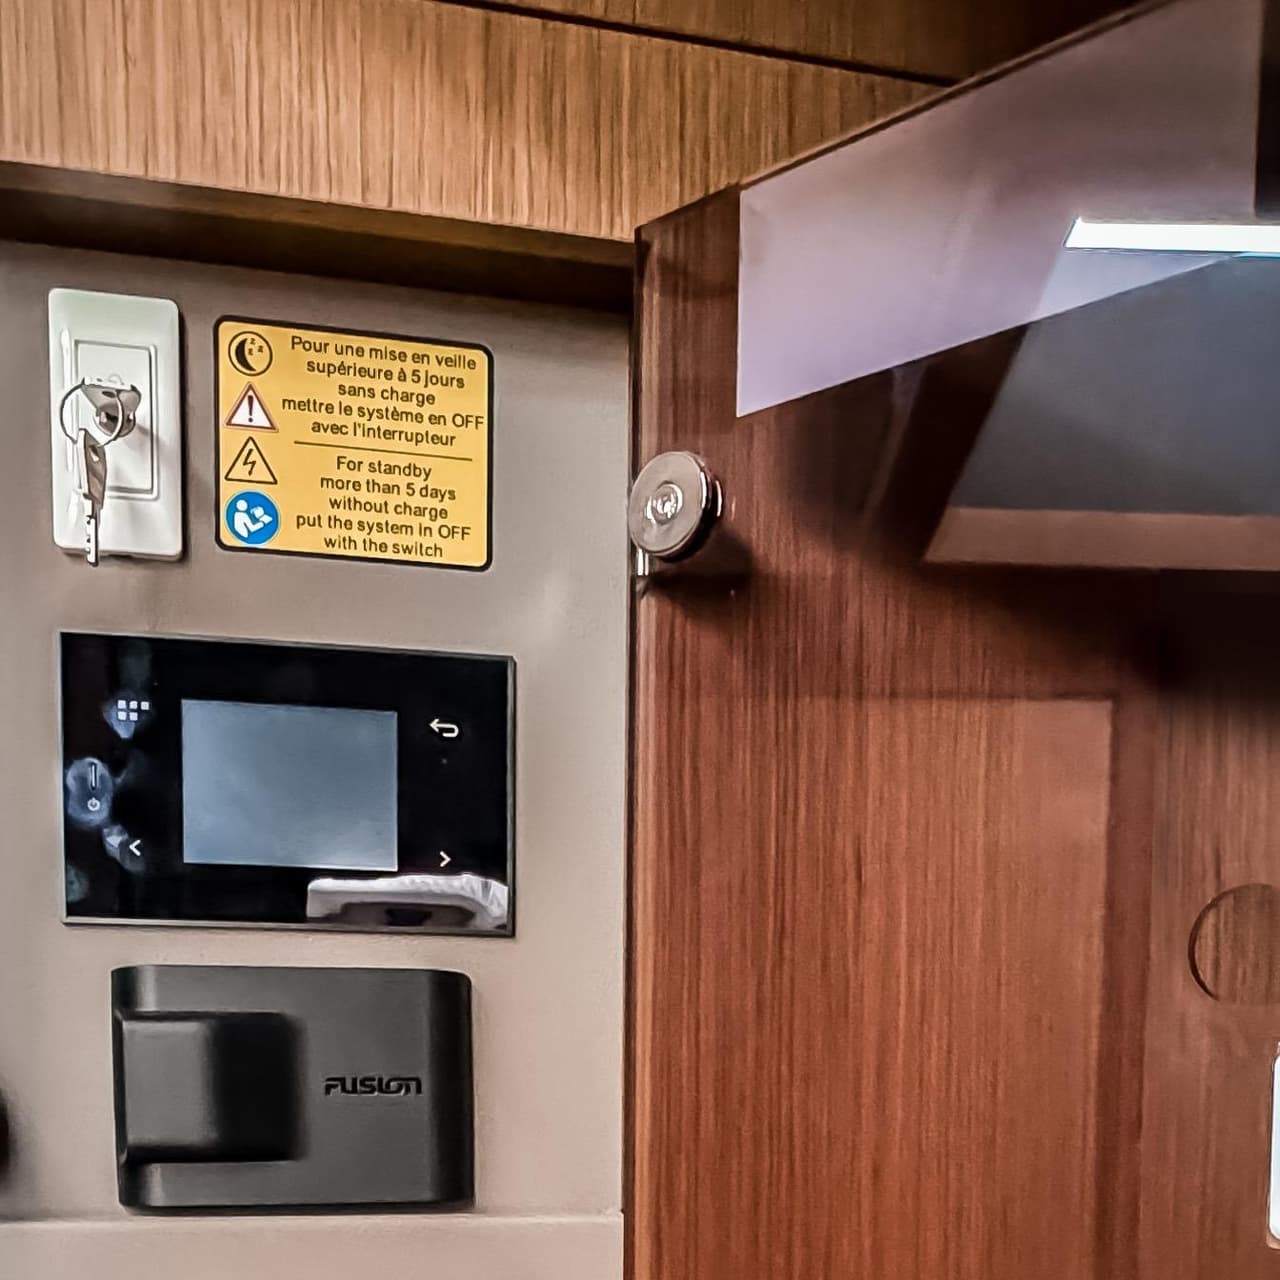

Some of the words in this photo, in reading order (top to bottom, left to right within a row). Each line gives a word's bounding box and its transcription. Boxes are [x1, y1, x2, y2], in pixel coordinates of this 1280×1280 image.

[291, 336, 329, 352] Pour
[335, 344, 365, 358] une
[370, 347, 406, 361] mise
[412, 352, 430, 364] en
[435, 353, 476, 370] veille
[307, 359, 393, 381] supérieure
[398, 366, 407, 382] à
[412, 367, 420, 382] 5
[424, 369, 464, 388] jours
[338, 383, 375, 399] sans
[381, 386, 435, 407] charge
[282, 397, 334, 413] mettre
[339, 401, 353, 415] le
[358, 407, 423, 423] système
[429, 412, 447, 425] en
[452, 414, 484, 429] OFF
[312, 421, 348, 435] avec
[354, 422, 456, 446] l'interrupteur
[337, 456, 363, 471] For
[368, 460, 432, 481] standby
[321, 478, 361, 491] more
[366, 478, 400, 495] than
[406, 482, 415, 496] 5
[420, 483, 456, 502] days
[329, 496, 388, 514] without
[394, 502, 448, 520] charge
[296, 514, 322, 529] put
[328, 515, 352, 530] the
[357, 518, 413, 536] system
[419, 521, 433, 536] in
[439, 525, 471, 540] OFF
[324, 535, 357, 550] with
[363, 537, 387, 552] the
[393, 541, 442, 557] switch
[324, 1076, 422, 1097] FUSION
